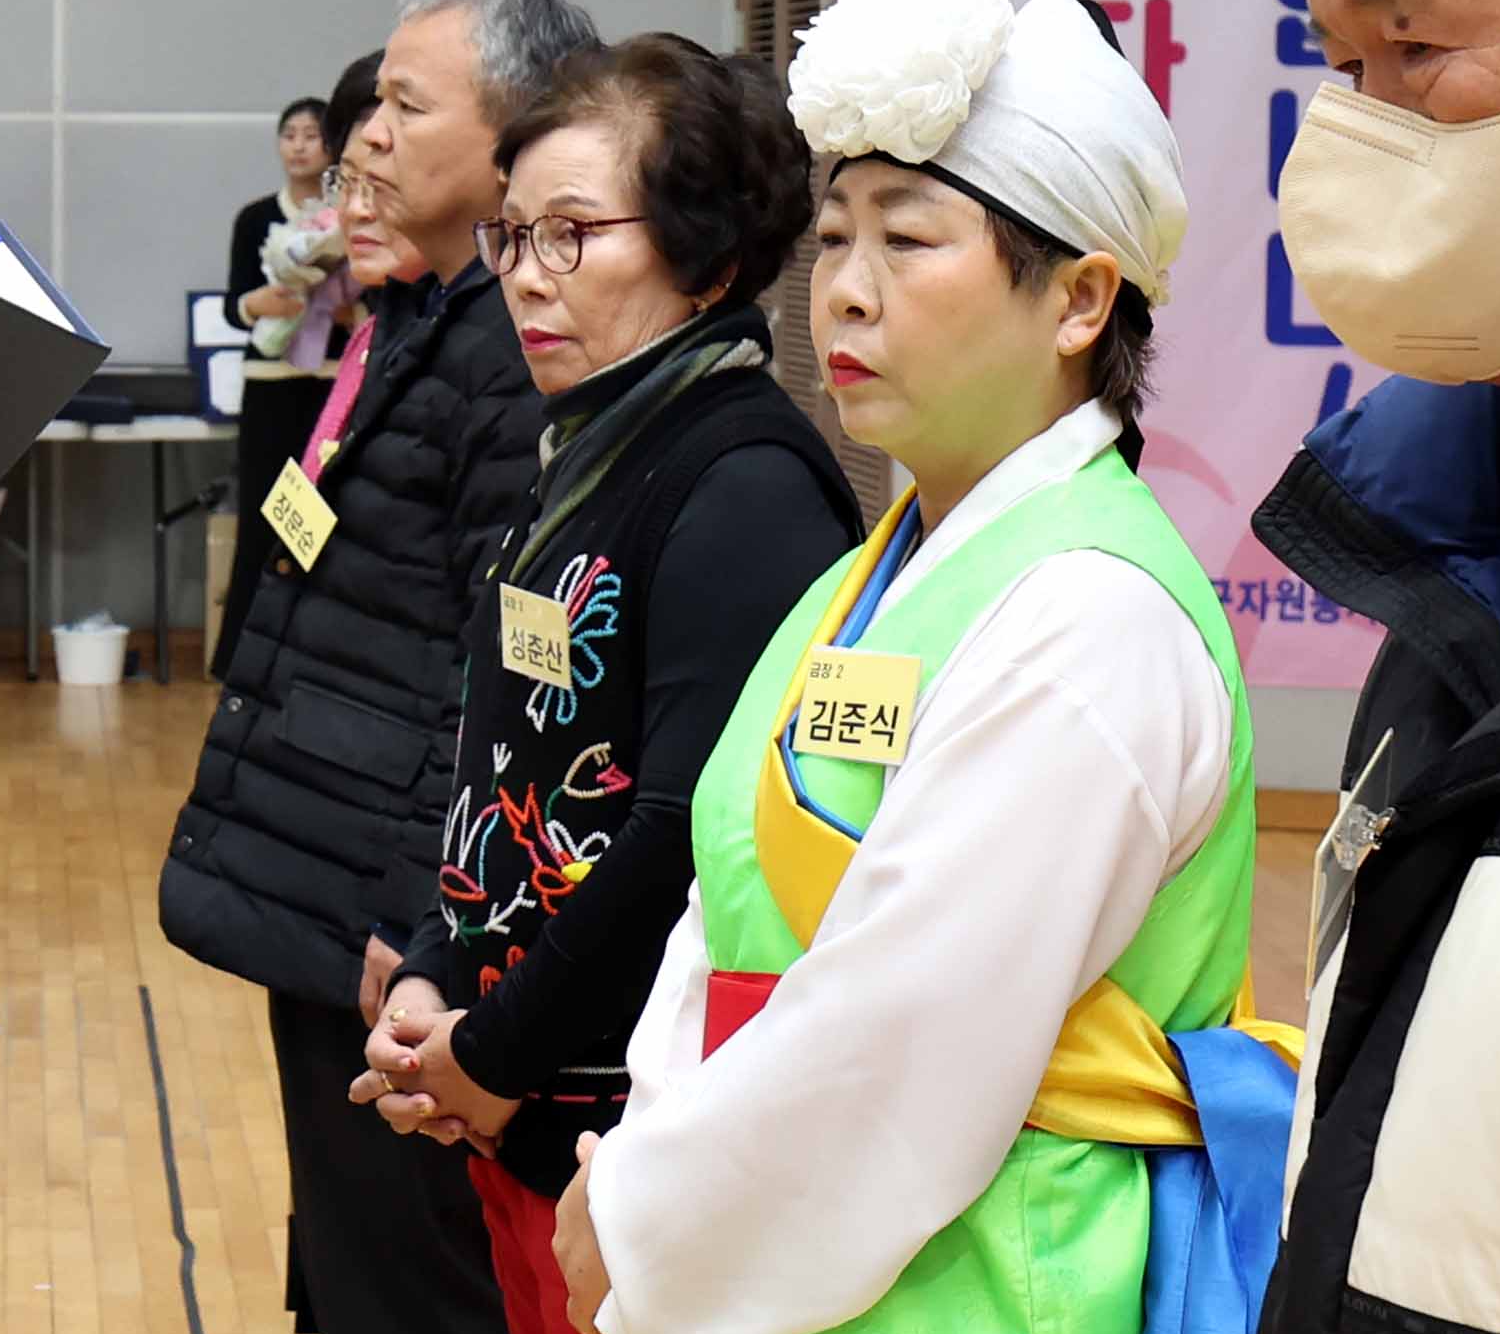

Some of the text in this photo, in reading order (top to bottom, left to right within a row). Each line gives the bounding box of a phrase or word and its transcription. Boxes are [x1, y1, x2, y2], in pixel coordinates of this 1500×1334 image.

[809, 661, 846, 680] 금장 2
[810, 700, 899, 748] 김준식
